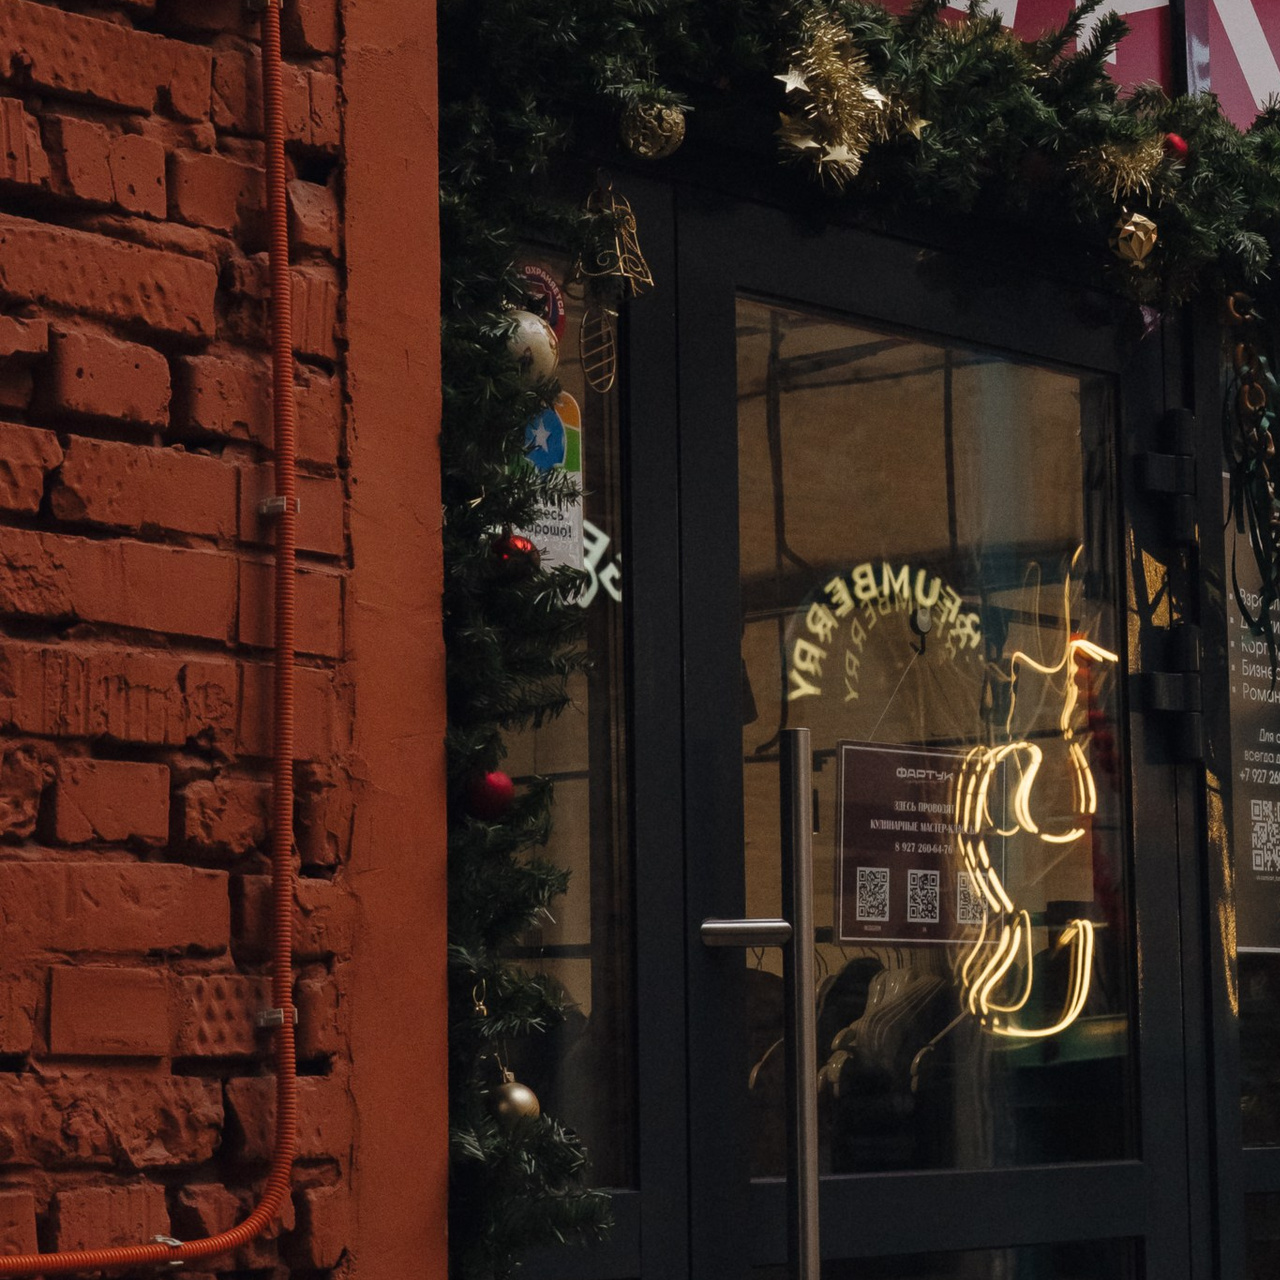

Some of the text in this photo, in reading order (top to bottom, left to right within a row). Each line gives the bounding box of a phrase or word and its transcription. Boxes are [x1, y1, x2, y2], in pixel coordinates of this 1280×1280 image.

[525, 265, 565, 316] ОХРАНЯЕТСЯ
[543, 509, 564, 521] есь
[1259, 728, 1274, 742] Для
[1244, 750, 1274, 763] всегда
[896, 767, 954, 781] ФАРТУК
[1239, 768, 1250, 781] +7
[1251, 768, 1267, 783] 927
[894, 801, 916, 812] ЗДЕСЬ
[870, 819, 918, 832] КУЛИНАРНЫЕ
[895, 843, 953, 855] 8 927 260-64-76
